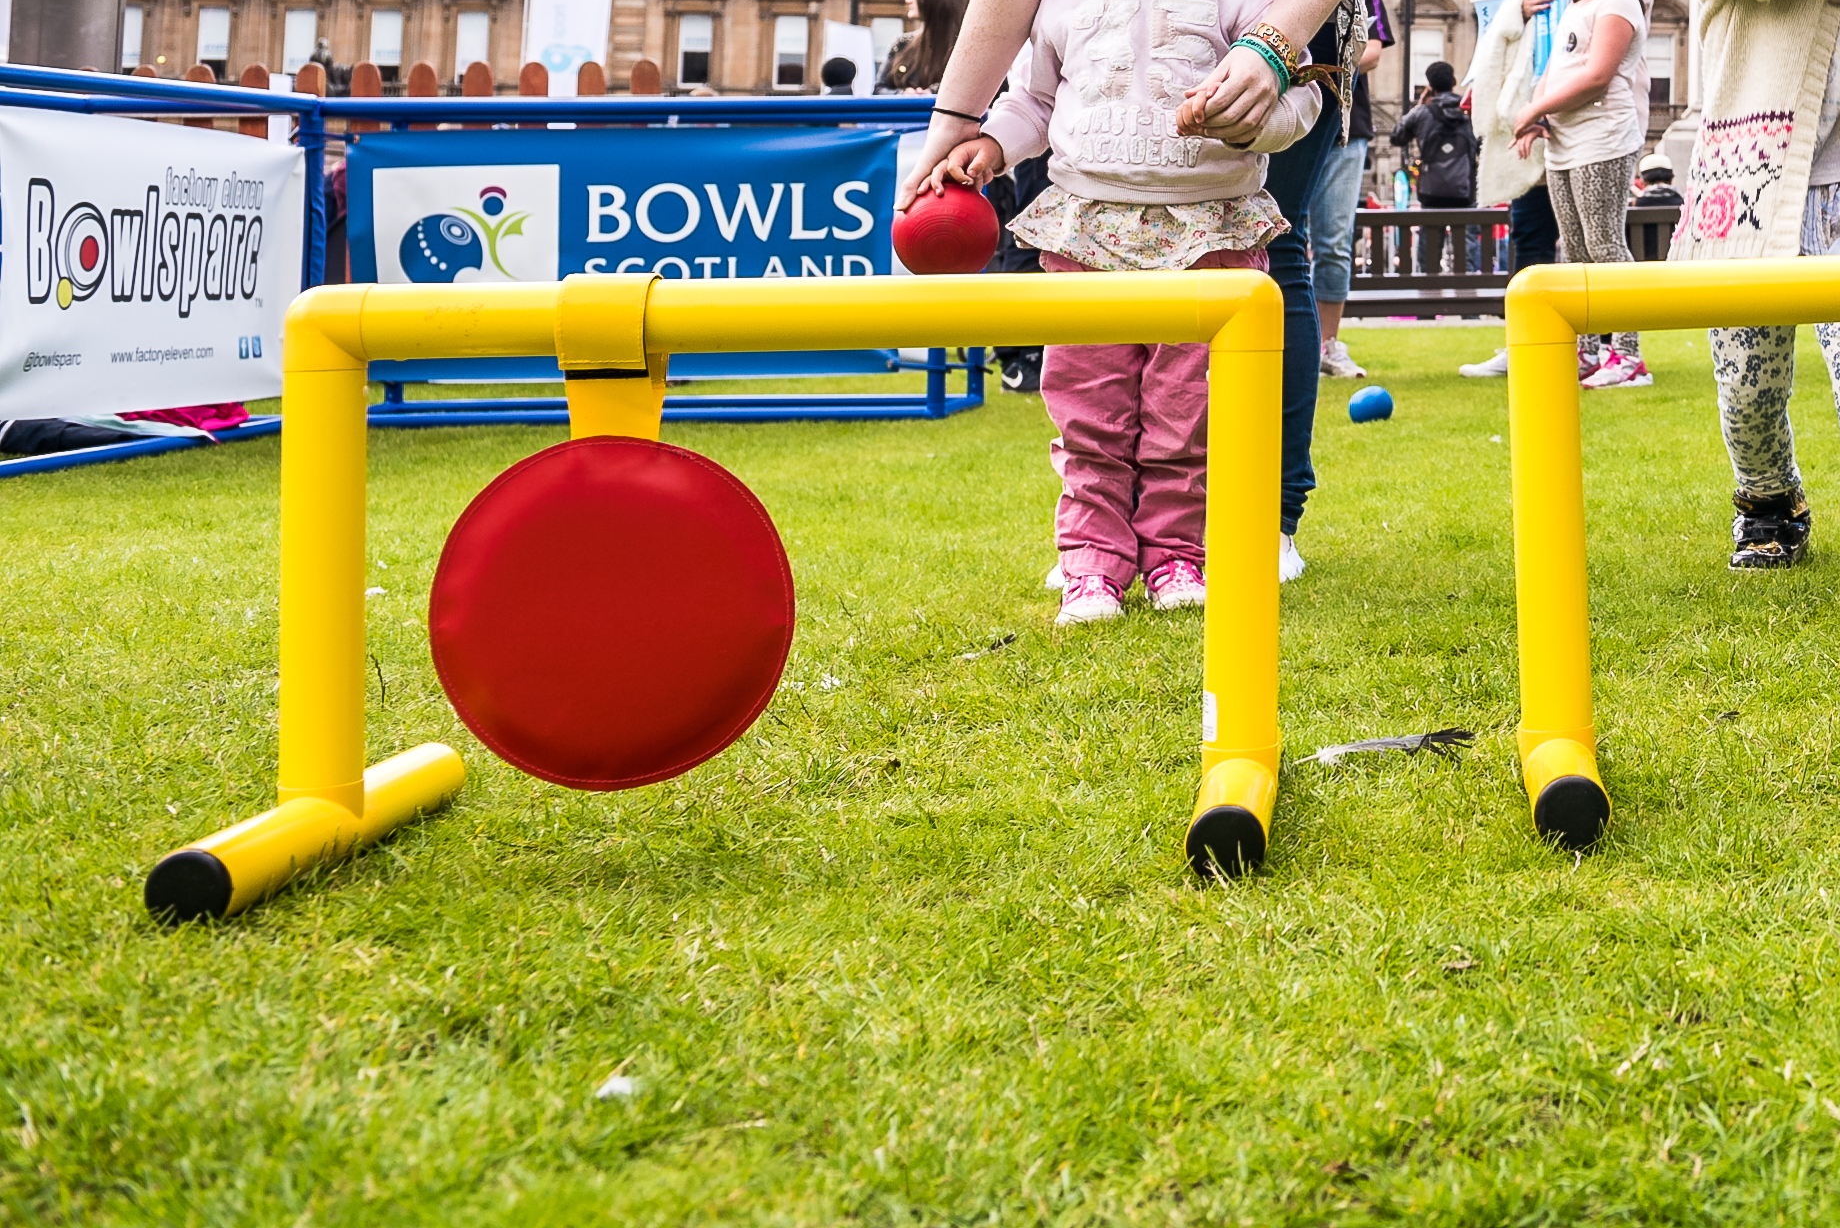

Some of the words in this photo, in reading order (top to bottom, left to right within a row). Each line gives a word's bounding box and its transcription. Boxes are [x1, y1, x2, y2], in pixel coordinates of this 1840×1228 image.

[1077, 134, 1203, 168] ACADEMY
[165, 166, 218, 213] factory
[221, 171, 264, 210] eleven
[586, 180, 874, 244] BOWLS
[27, 177, 263, 319] Bowlsparc
[110, 346, 214, 365] www.factoryeleven.com
